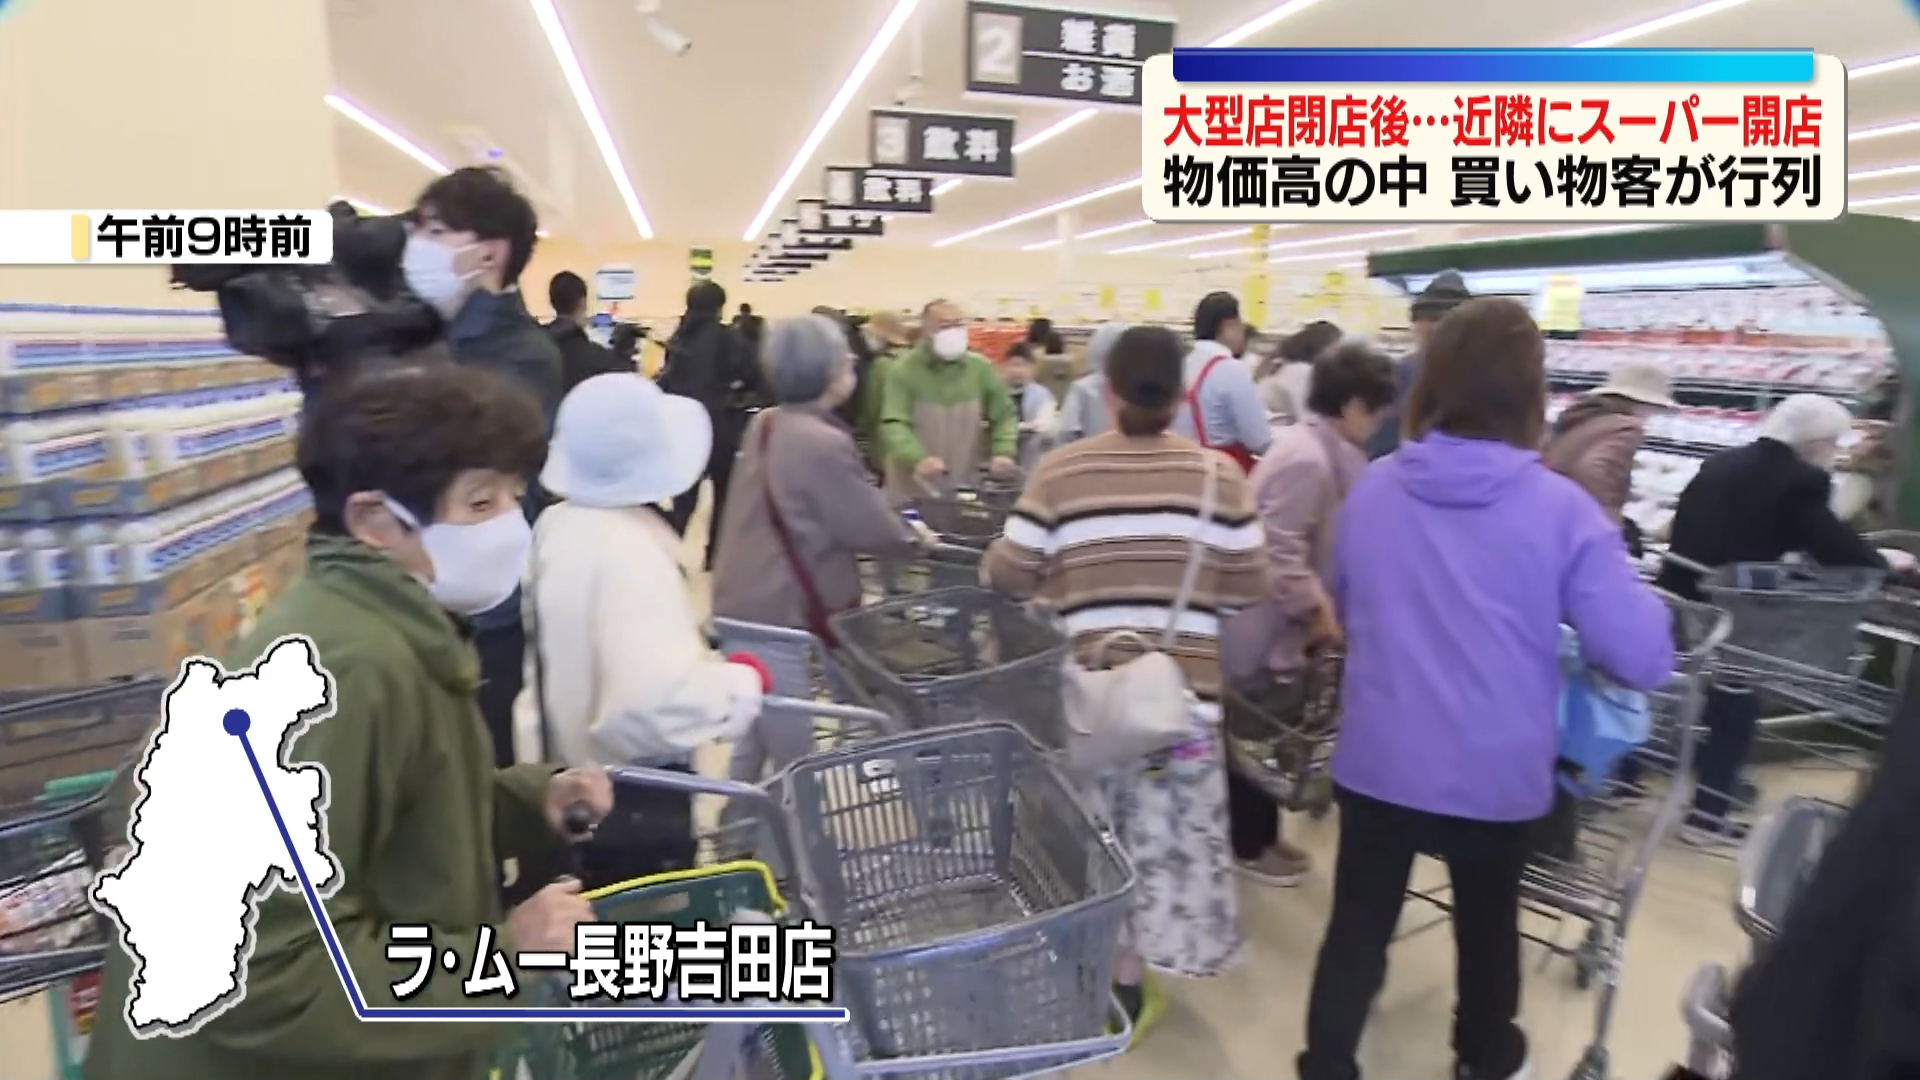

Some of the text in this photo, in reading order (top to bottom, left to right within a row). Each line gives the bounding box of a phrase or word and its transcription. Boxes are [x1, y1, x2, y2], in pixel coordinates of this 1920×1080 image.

[978, 27, 1013, 75] 2
[1060, 62, 1136, 97] お酒
[923, 125, 1000, 163] 飲料
